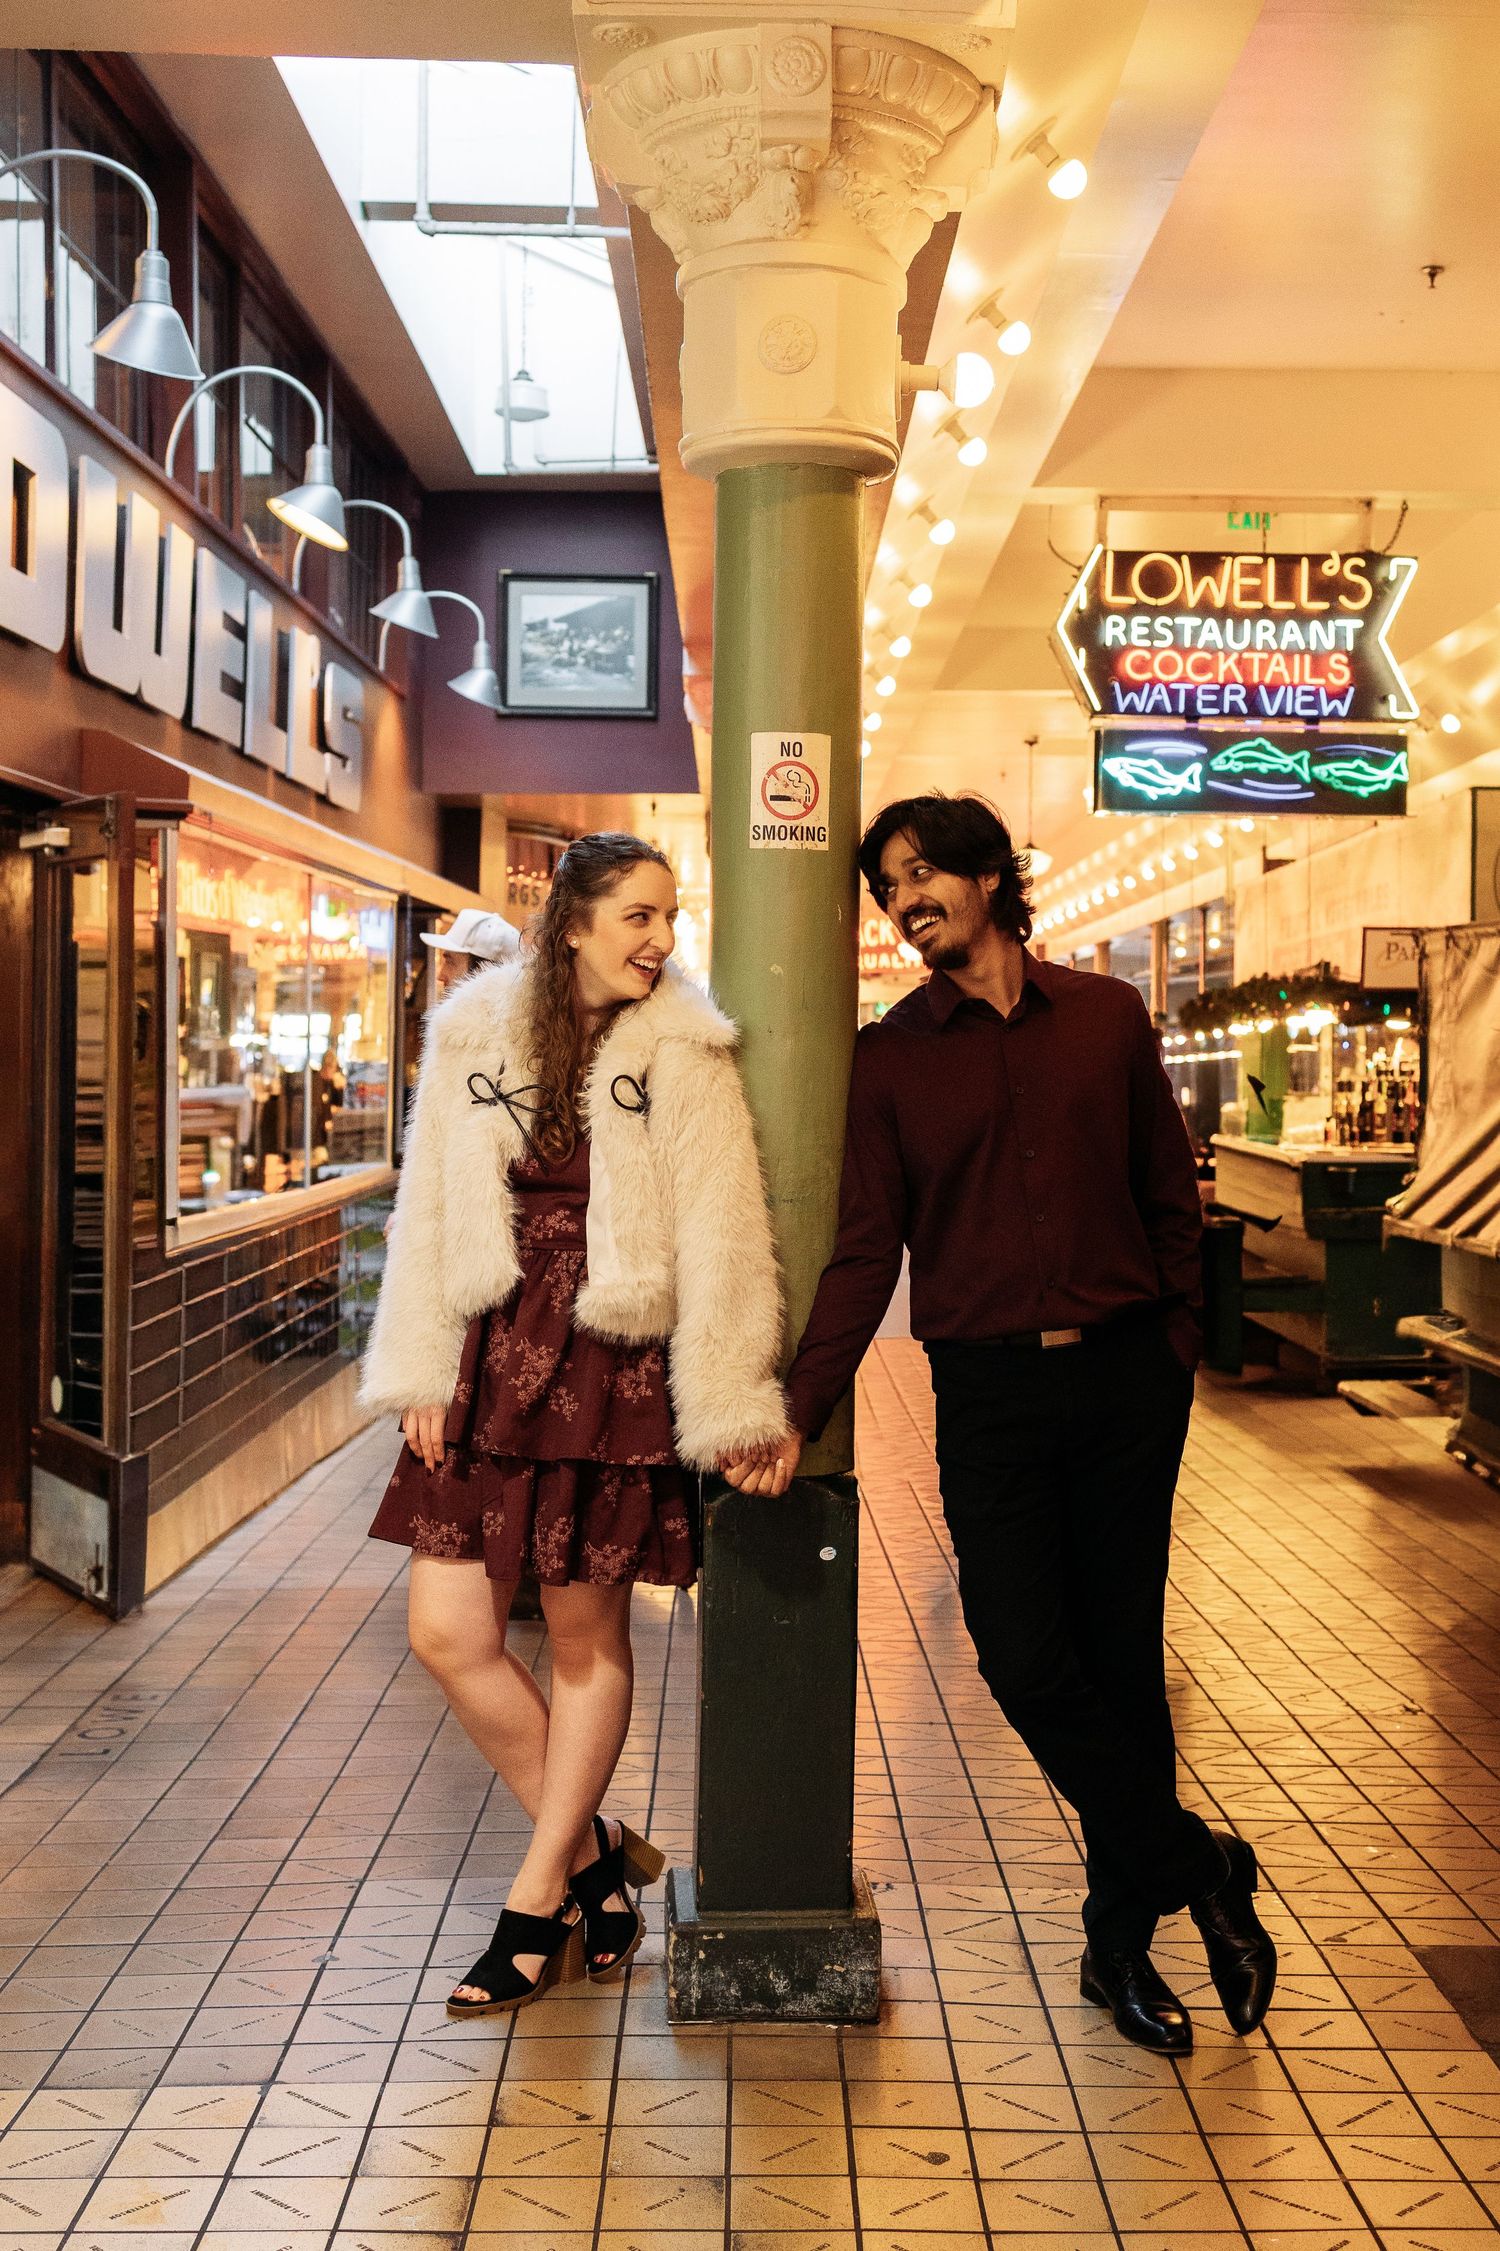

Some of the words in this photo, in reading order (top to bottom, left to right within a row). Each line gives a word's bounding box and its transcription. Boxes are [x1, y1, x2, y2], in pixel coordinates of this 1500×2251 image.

[1102, 551, 1373, 610] LOWELL'S
[1105, 615, 1364, 652] RESTAURANT
[1124, 650, 1351, 686] COCKTAILS
[1113, 682, 1249, 715] WATER
[1258, 685, 1355, 718] VIEW
[780, 741, 803, 757] NO
[752, 825, 827, 842] SMOKING
[161, 2189, 191, 2200] CONNIE
[406, 2190, 441, 2204] CHARLES
[107, 2203, 150, 2219] PETERSON
